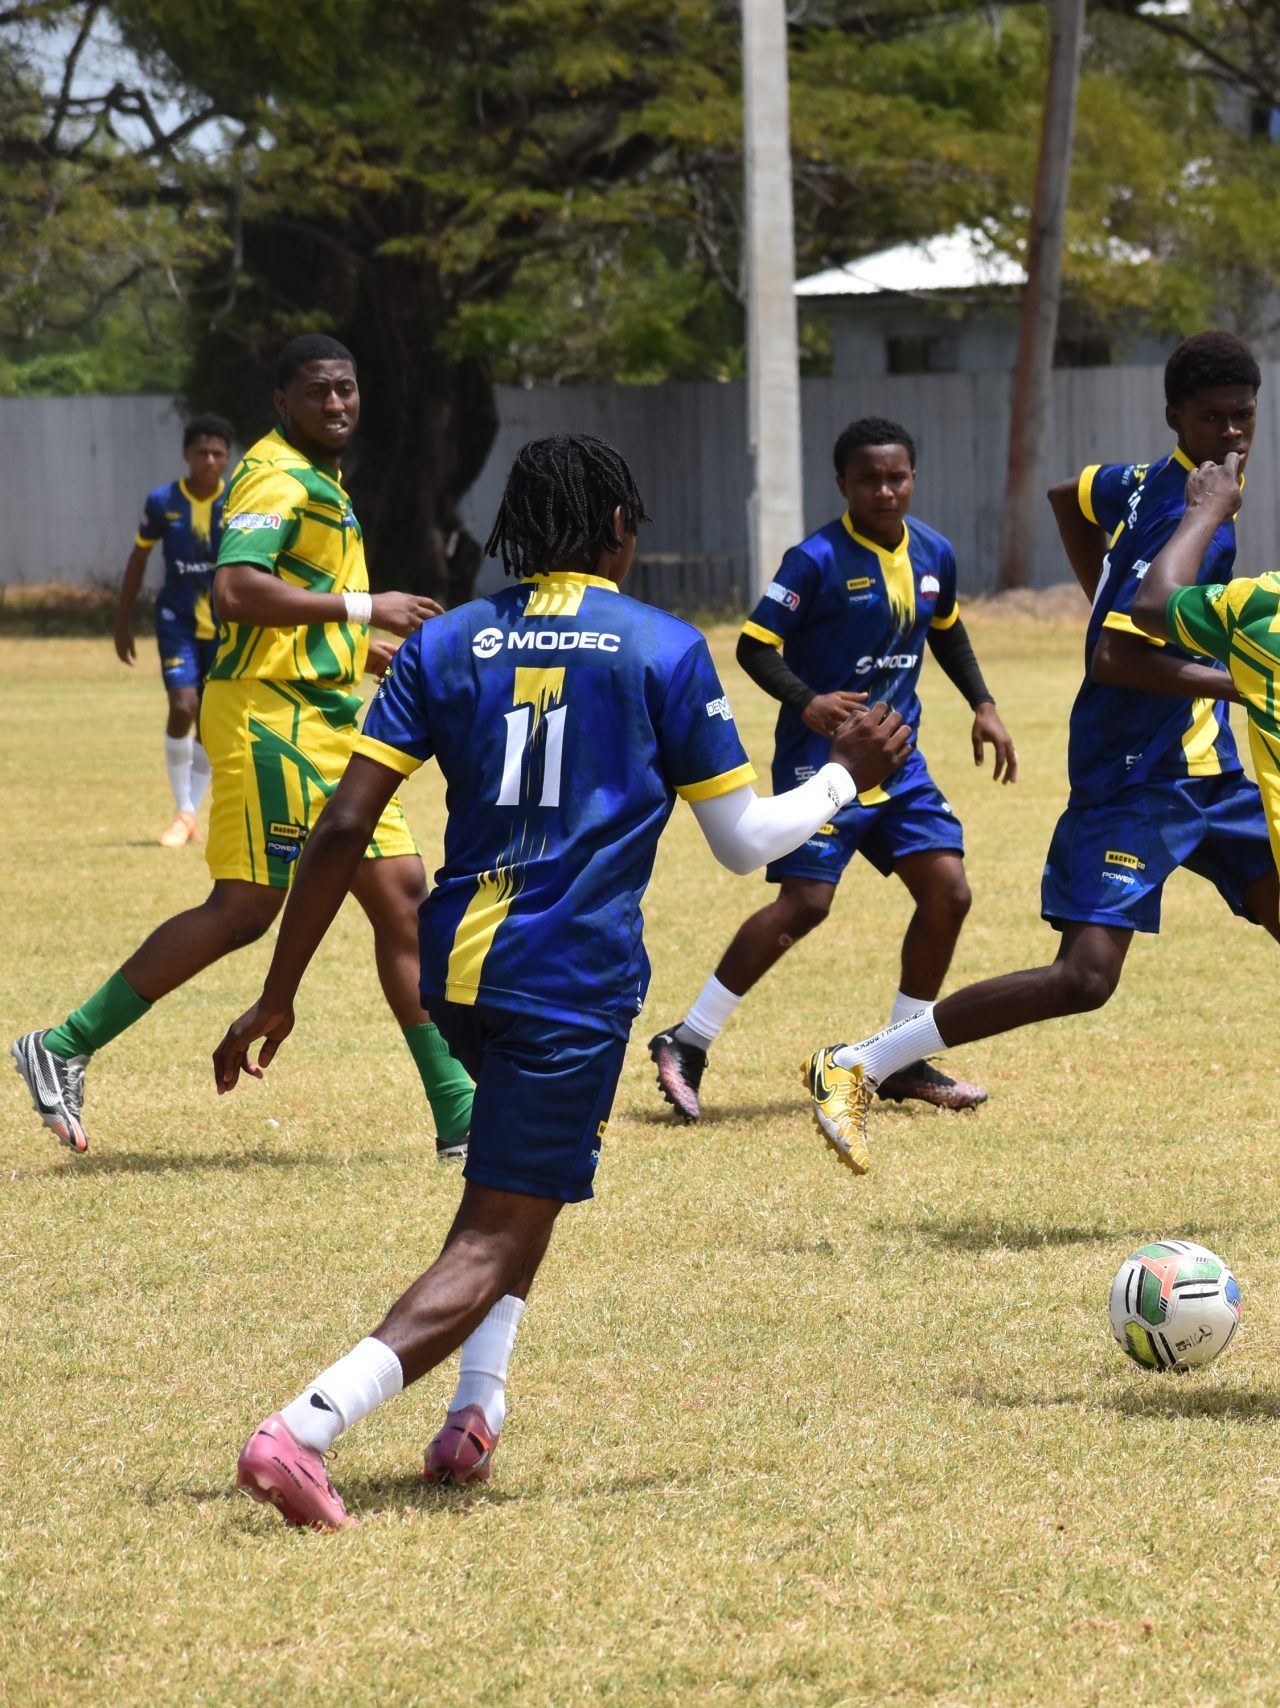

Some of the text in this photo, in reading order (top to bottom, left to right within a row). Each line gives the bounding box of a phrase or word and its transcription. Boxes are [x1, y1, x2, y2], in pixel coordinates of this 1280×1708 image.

[507, 631, 621, 653] MODEC
[495, 704, 567, 807] 11
[268, 842, 296, 852] POWER
[1102, 871, 1135, 885] POWER
